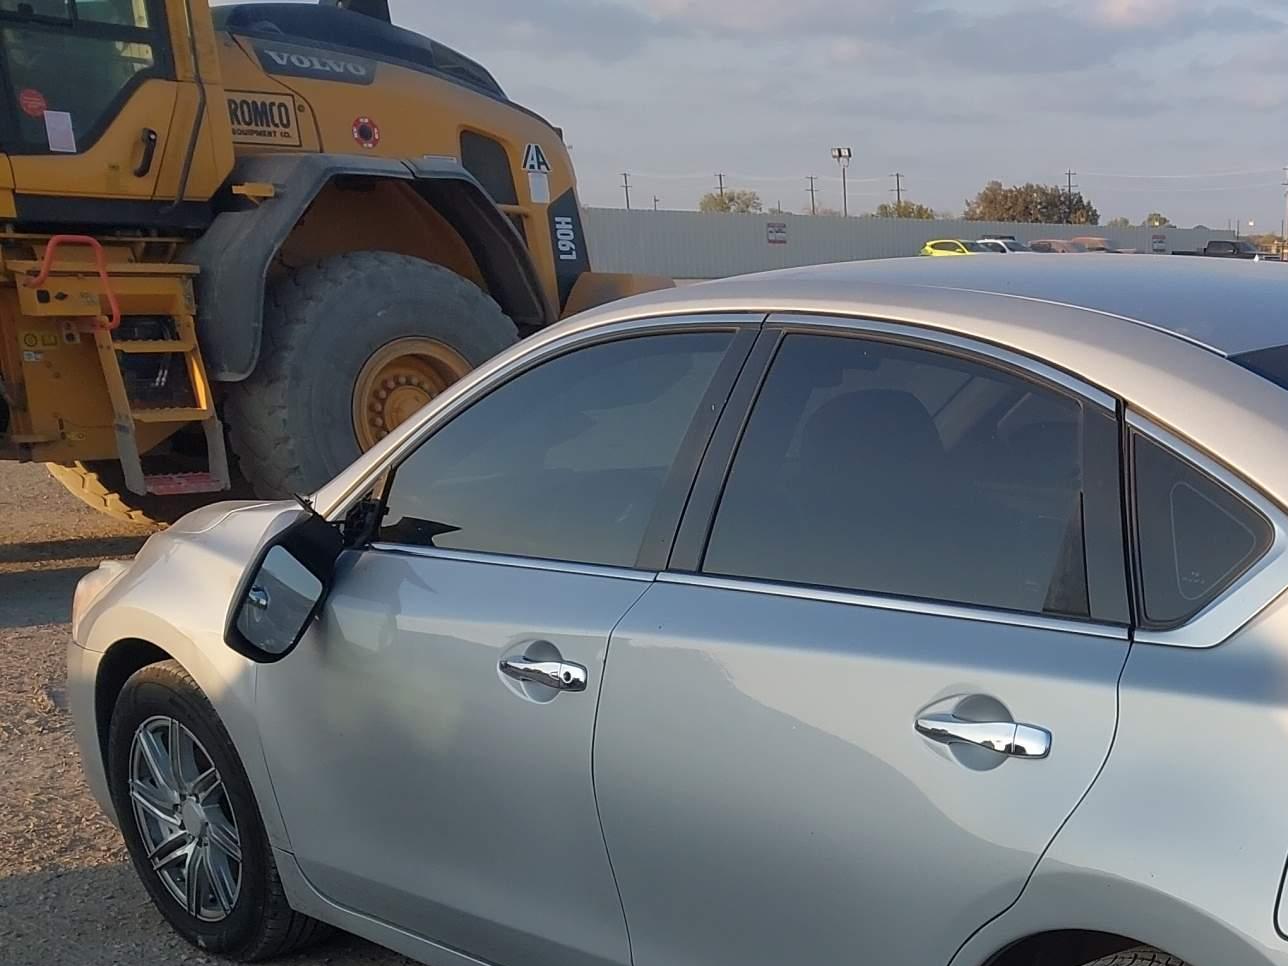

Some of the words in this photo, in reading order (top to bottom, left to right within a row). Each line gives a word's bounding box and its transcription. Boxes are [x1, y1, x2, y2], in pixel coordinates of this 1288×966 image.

[264, 50, 366, 75] VOLVO
[227, 98, 291, 129] ROMCO
[555, 216, 577, 260] L90H
